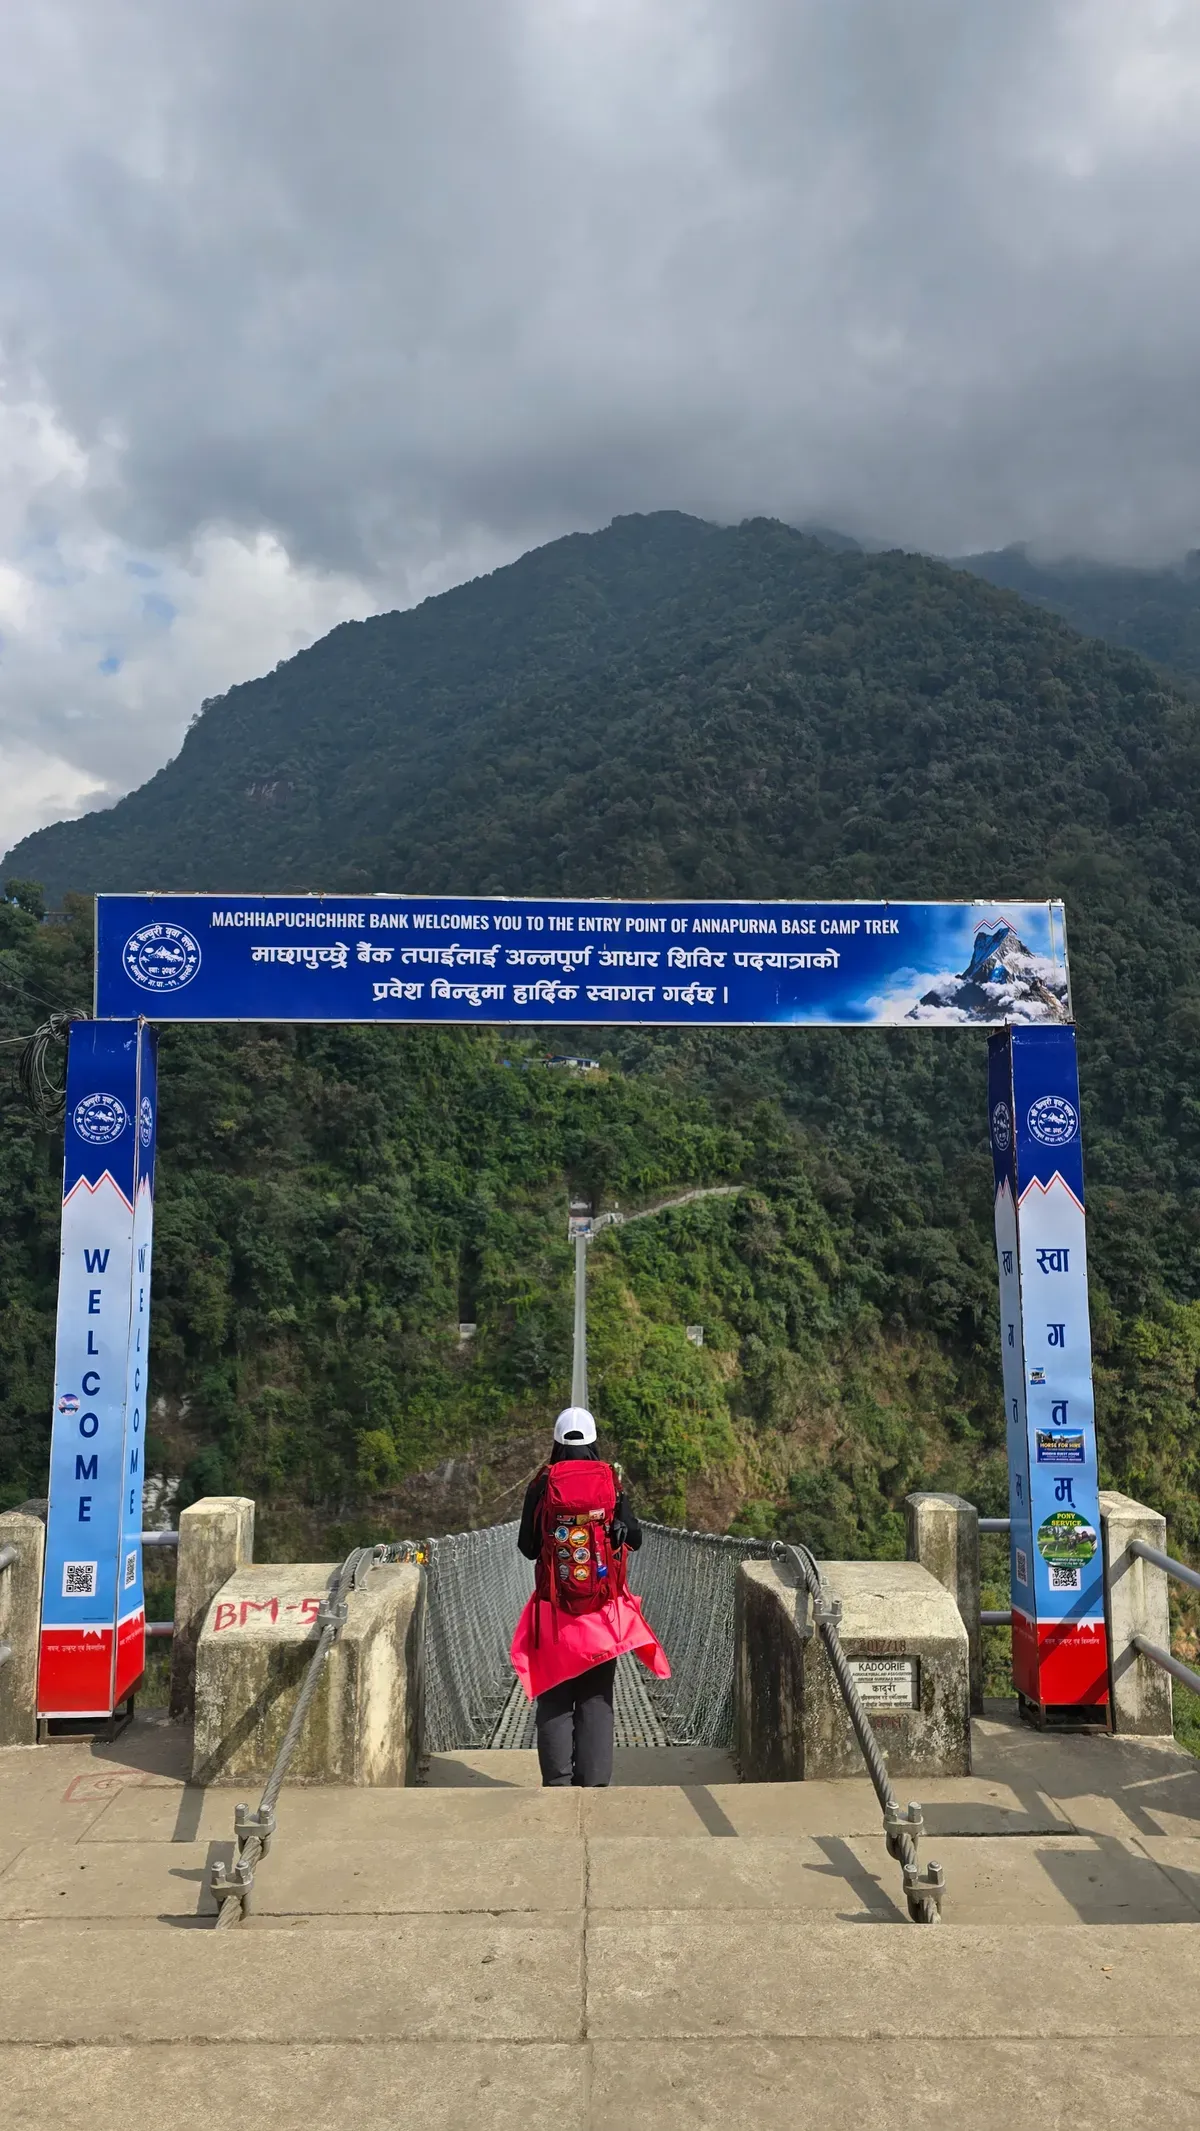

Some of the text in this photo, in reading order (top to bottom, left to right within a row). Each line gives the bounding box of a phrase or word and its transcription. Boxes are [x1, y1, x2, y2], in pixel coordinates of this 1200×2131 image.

[213, 912, 899, 935] MACHHAPUCHCHHRE BANK WELCOMES YOU TO THE ENTRY POINT OF ANNAPURNA BASE CAMP TREK
[251, 941, 350, 969] माछापुच्छ्रे
[357, 941, 395, 964] बैंक
[505, 946, 594, 972] अन्नपूर्ण
[598, 949, 660, 968] आधार
[667, 947, 727, 969] शिविर
[733, 948, 840, 971] पदयात्राको
[373, 978, 424, 1001] प्रवेश
[431, 978, 506, 1006] बिन्दुमा
[513, 980, 579, 1004] हार्दिक
[586, 984, 655, 1003] स्वागत
[662, 982, 717, 1005] गर्दछ
[75, 1249, 110, 1522] WELCOME
[129, 1249, 146, 1515] WELCOME
[1036, 1248, 1076, 1509] स्वागतम्
[859, 1662, 905, 1671] KADOORIE
